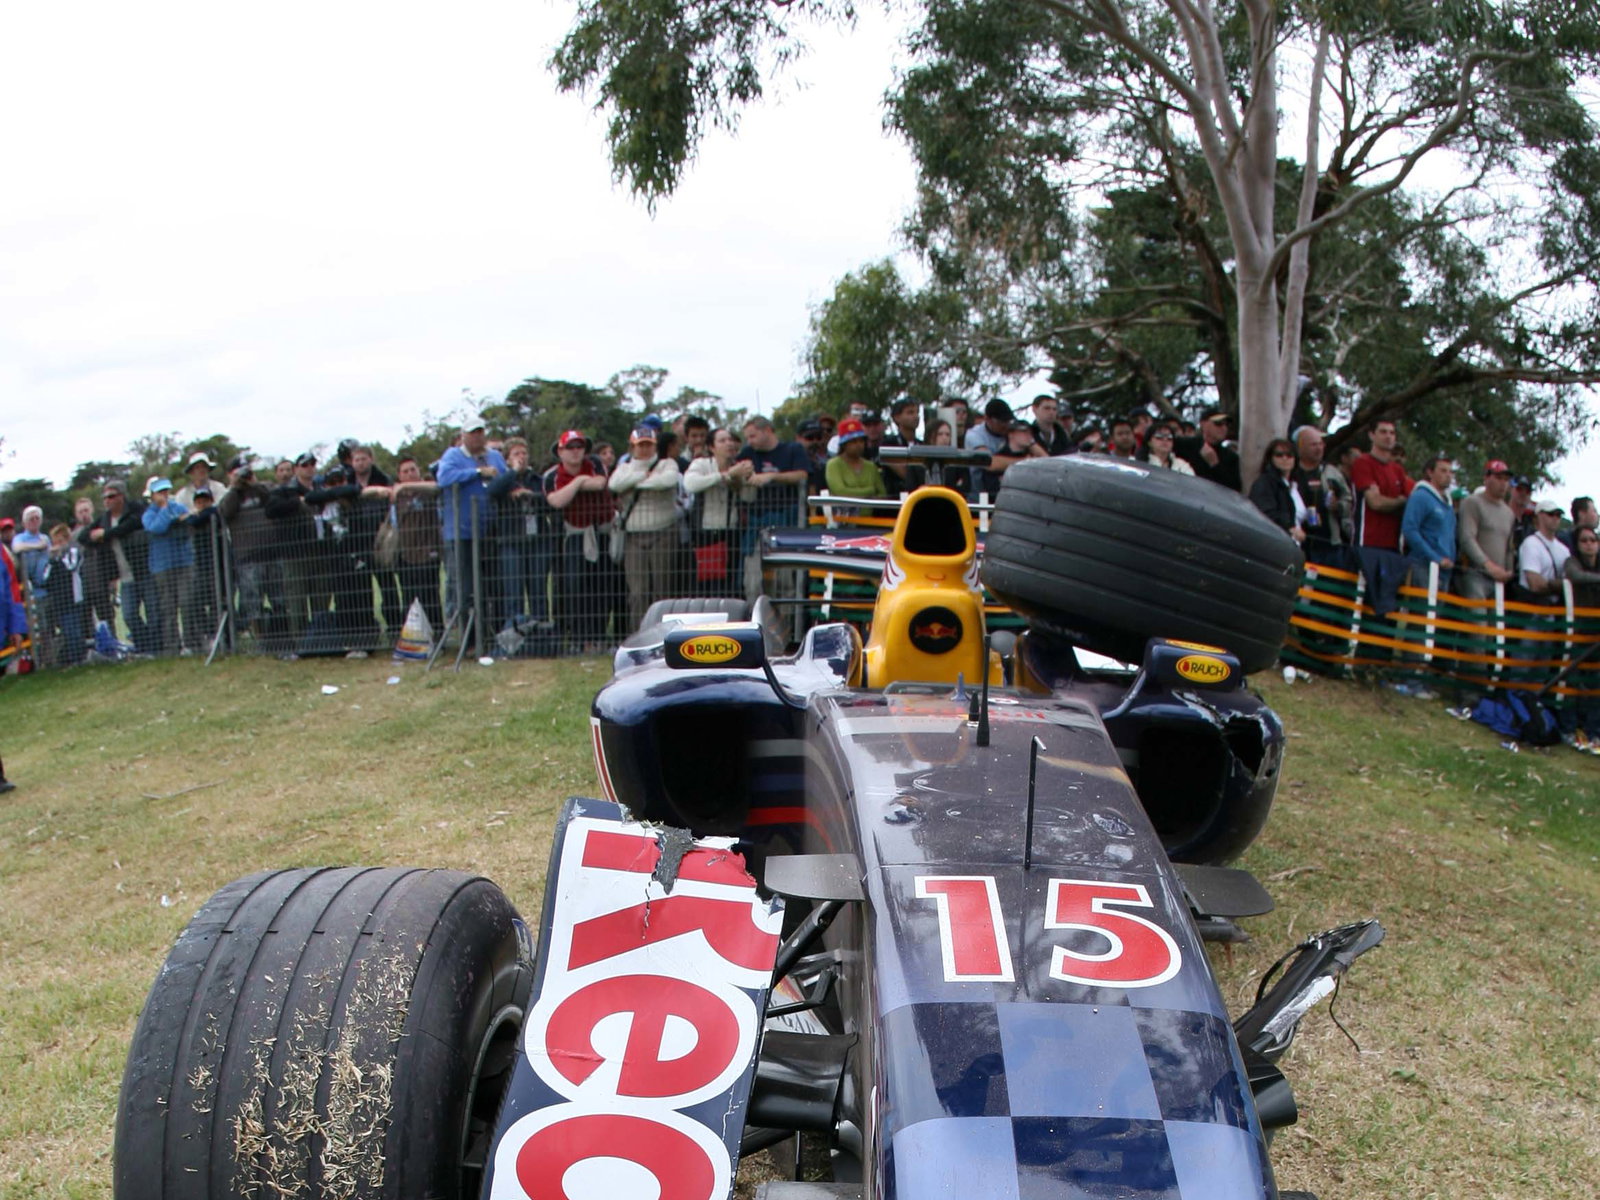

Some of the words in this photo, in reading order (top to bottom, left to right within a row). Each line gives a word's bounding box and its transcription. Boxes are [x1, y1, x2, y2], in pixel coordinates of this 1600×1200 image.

[695, 643, 734, 656] RAUCH
[1190, 661, 1225, 677] RAUCH
[914, 876, 1182, 988] 15
